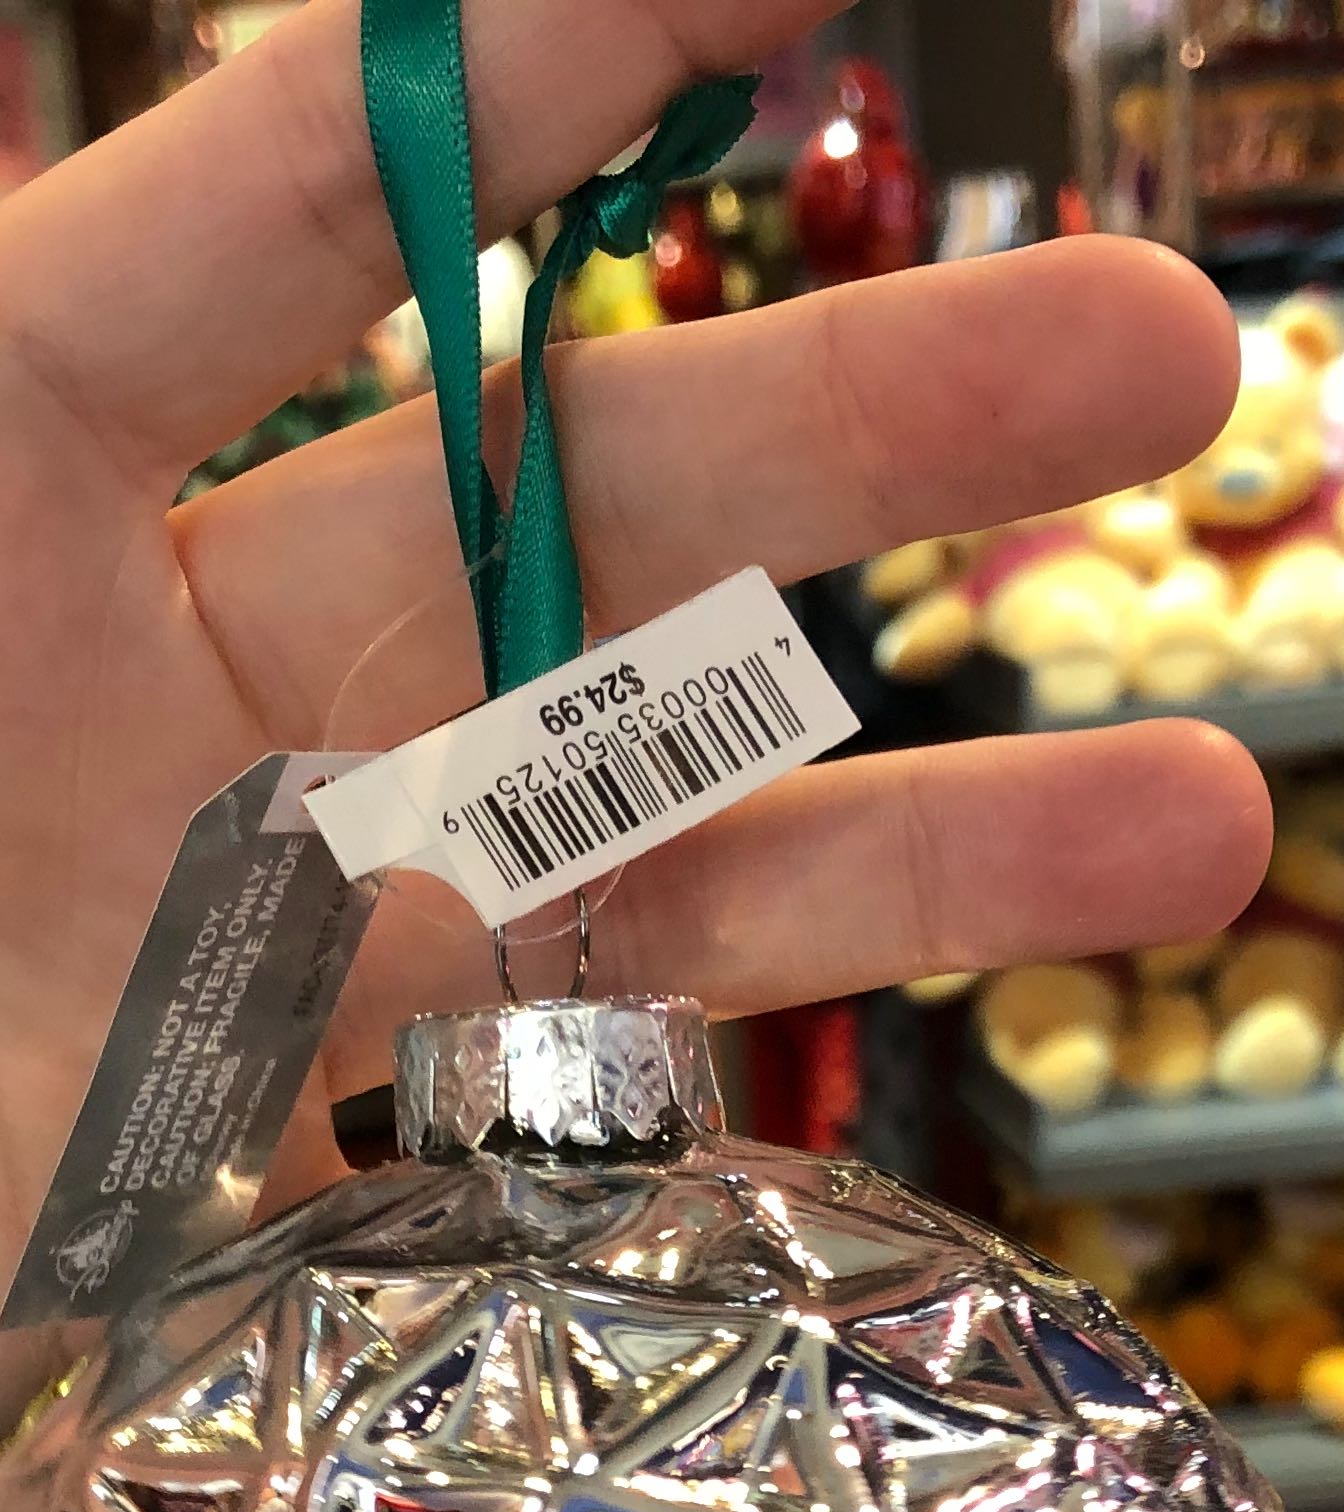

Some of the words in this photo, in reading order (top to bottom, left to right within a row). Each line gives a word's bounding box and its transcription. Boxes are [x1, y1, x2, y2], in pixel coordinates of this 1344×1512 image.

[774, 636, 792, 657] 4
[539, 661, 645, 736] $24.99
[617, 665, 729, 744] 00035
[496, 729, 608, 806] 50125
[442, 810, 460, 834] 9
[124, 1020, 208, 1190] DECORATIVE
[197, 946, 237, 1012] ITEM
[225, 859, 273, 936] ONLY.
[150, 1060, 217, 1185] CAUTION:
[258, 837, 307, 921] MADE
[100, 1062, 165, 1193] CAUTION:
[151, 999, 190, 1058] NOT
[181, 973, 201, 993] A
[176, 1149, 201, 1182] OF
[192, 1050, 245, 1142] GLASS.
